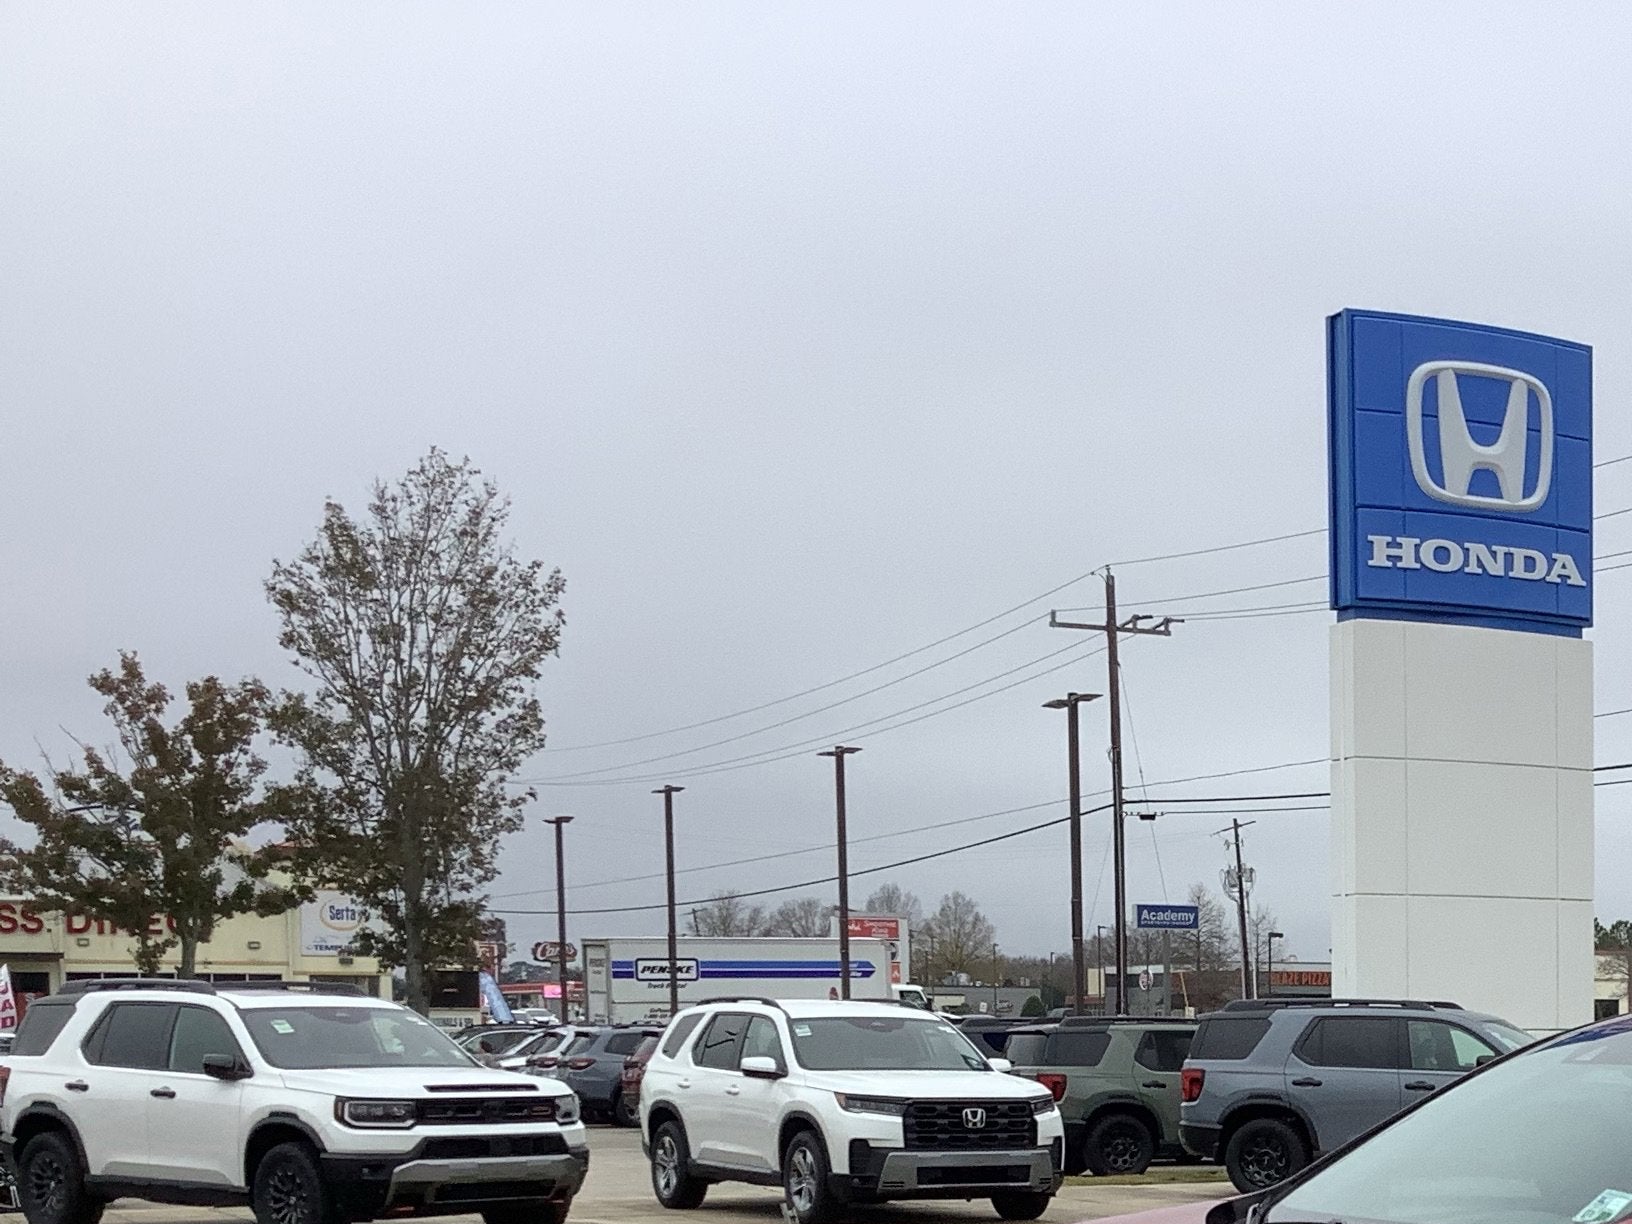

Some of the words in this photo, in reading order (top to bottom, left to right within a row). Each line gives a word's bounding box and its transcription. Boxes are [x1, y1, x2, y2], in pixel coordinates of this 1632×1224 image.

[1367, 534, 1587, 587] HONDA
[329, 905, 356, 921] Serta
[1141, 909, 1195, 924] Academy
